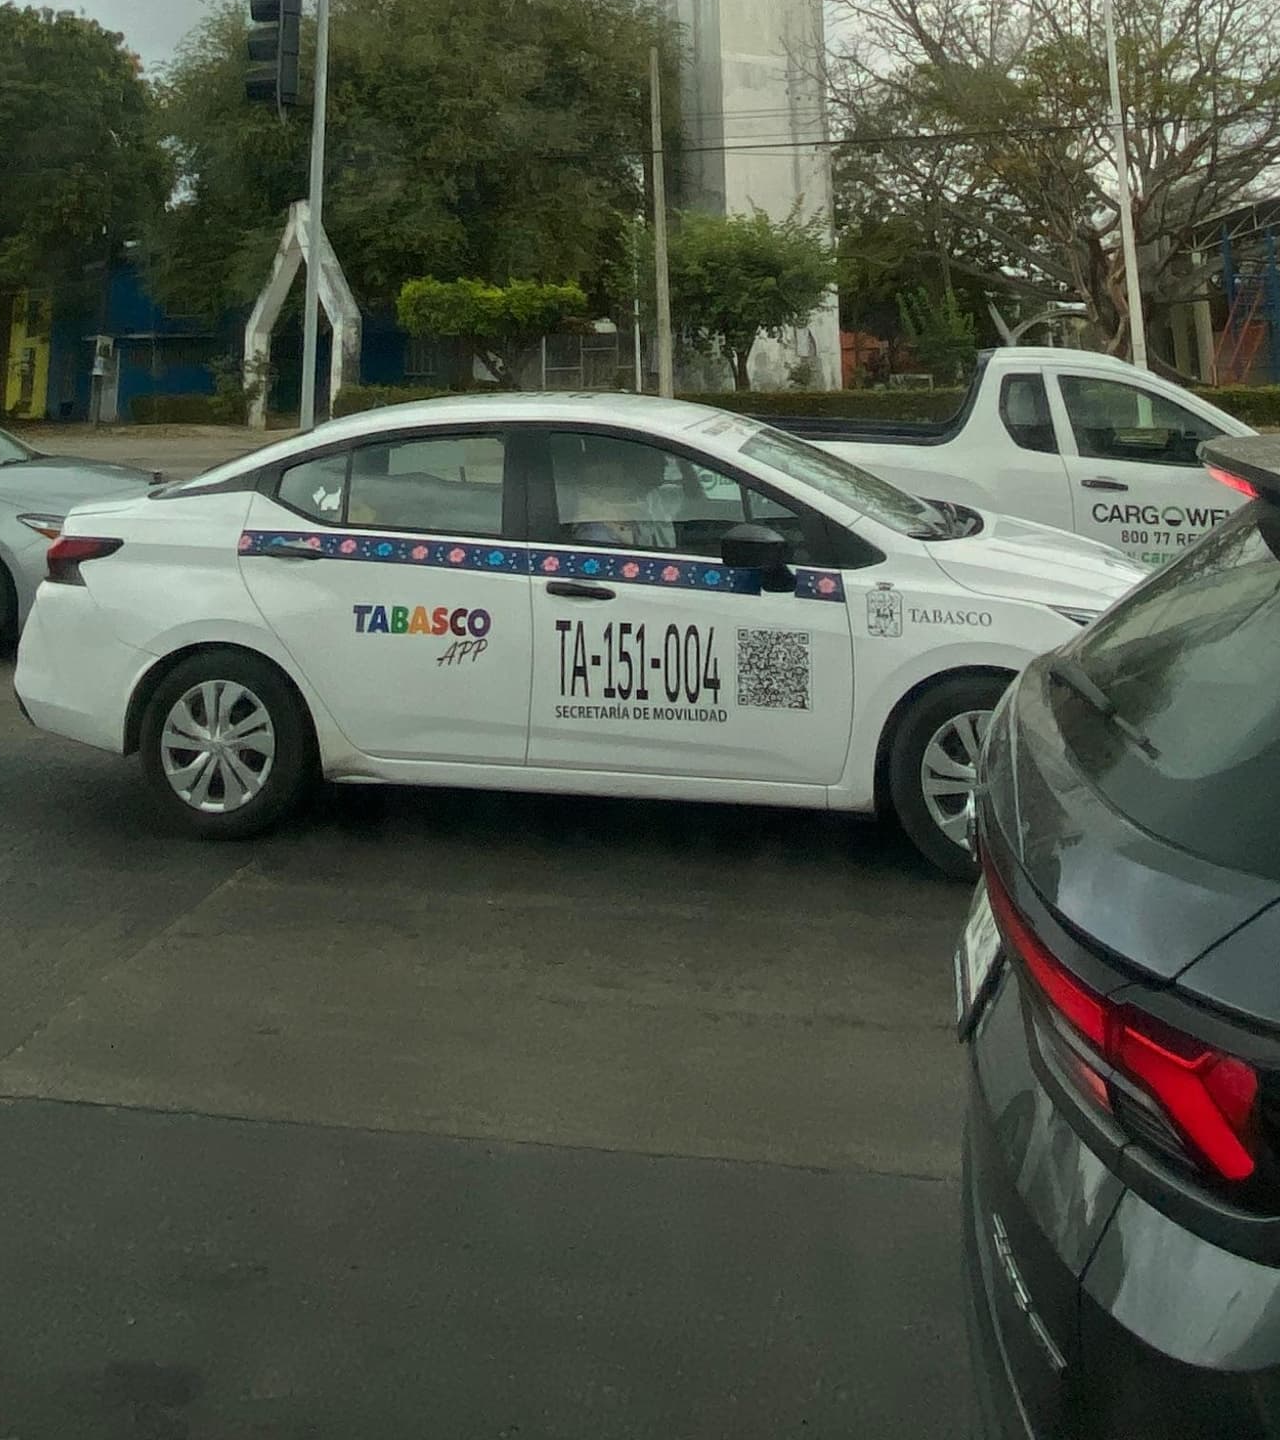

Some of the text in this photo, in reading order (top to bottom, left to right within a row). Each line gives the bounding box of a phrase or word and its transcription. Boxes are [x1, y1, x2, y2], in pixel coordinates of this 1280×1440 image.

[1092, 503, 1232, 527] CARGOWE
[1121, 530, 1203, 547] 800 77 RE
[353, 605, 491, 637] TABASCO
[908, 608, 993, 627] TABASCO
[436, 638, 488, 667] APP
[555, 620, 721, 705] TA-151-004
[555, 704, 728, 723] SECRETARÍA DE MOVILIDAD
